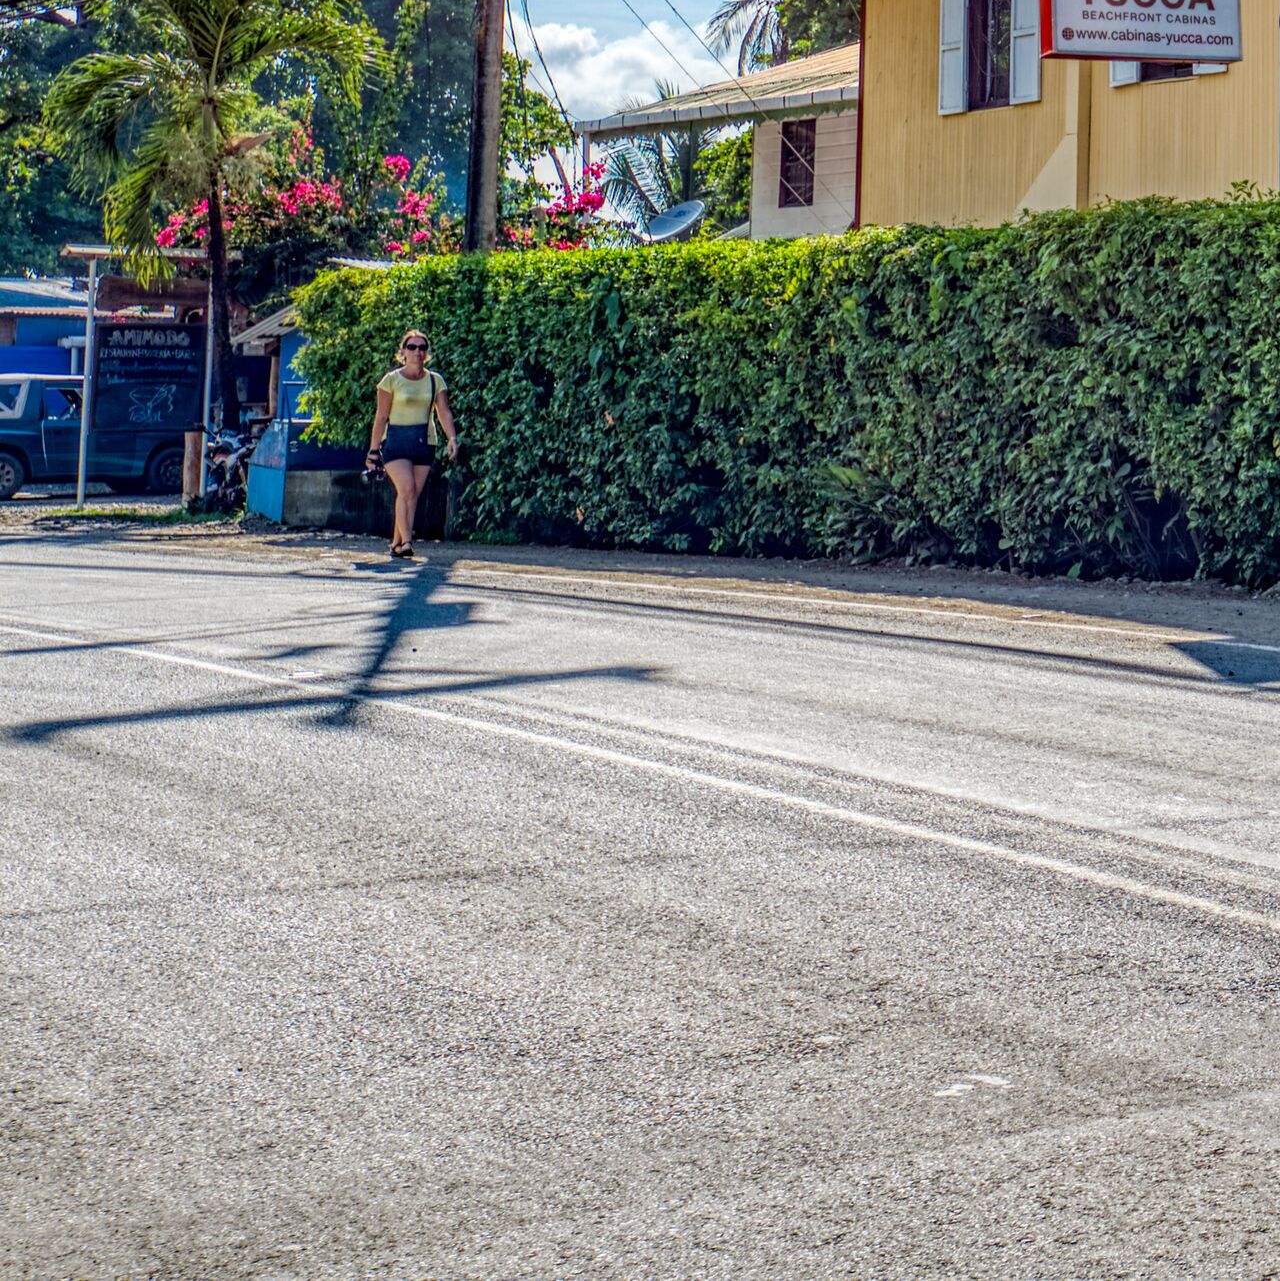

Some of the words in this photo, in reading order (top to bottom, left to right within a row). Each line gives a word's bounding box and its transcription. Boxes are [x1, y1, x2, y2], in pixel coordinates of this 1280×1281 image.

[1082, 10, 1162, 23] BEACHFRONT
[1166, 13, 1216, 25] CABINAS
[1076, 27, 1233, 46] www.cabinas-yucca.com
